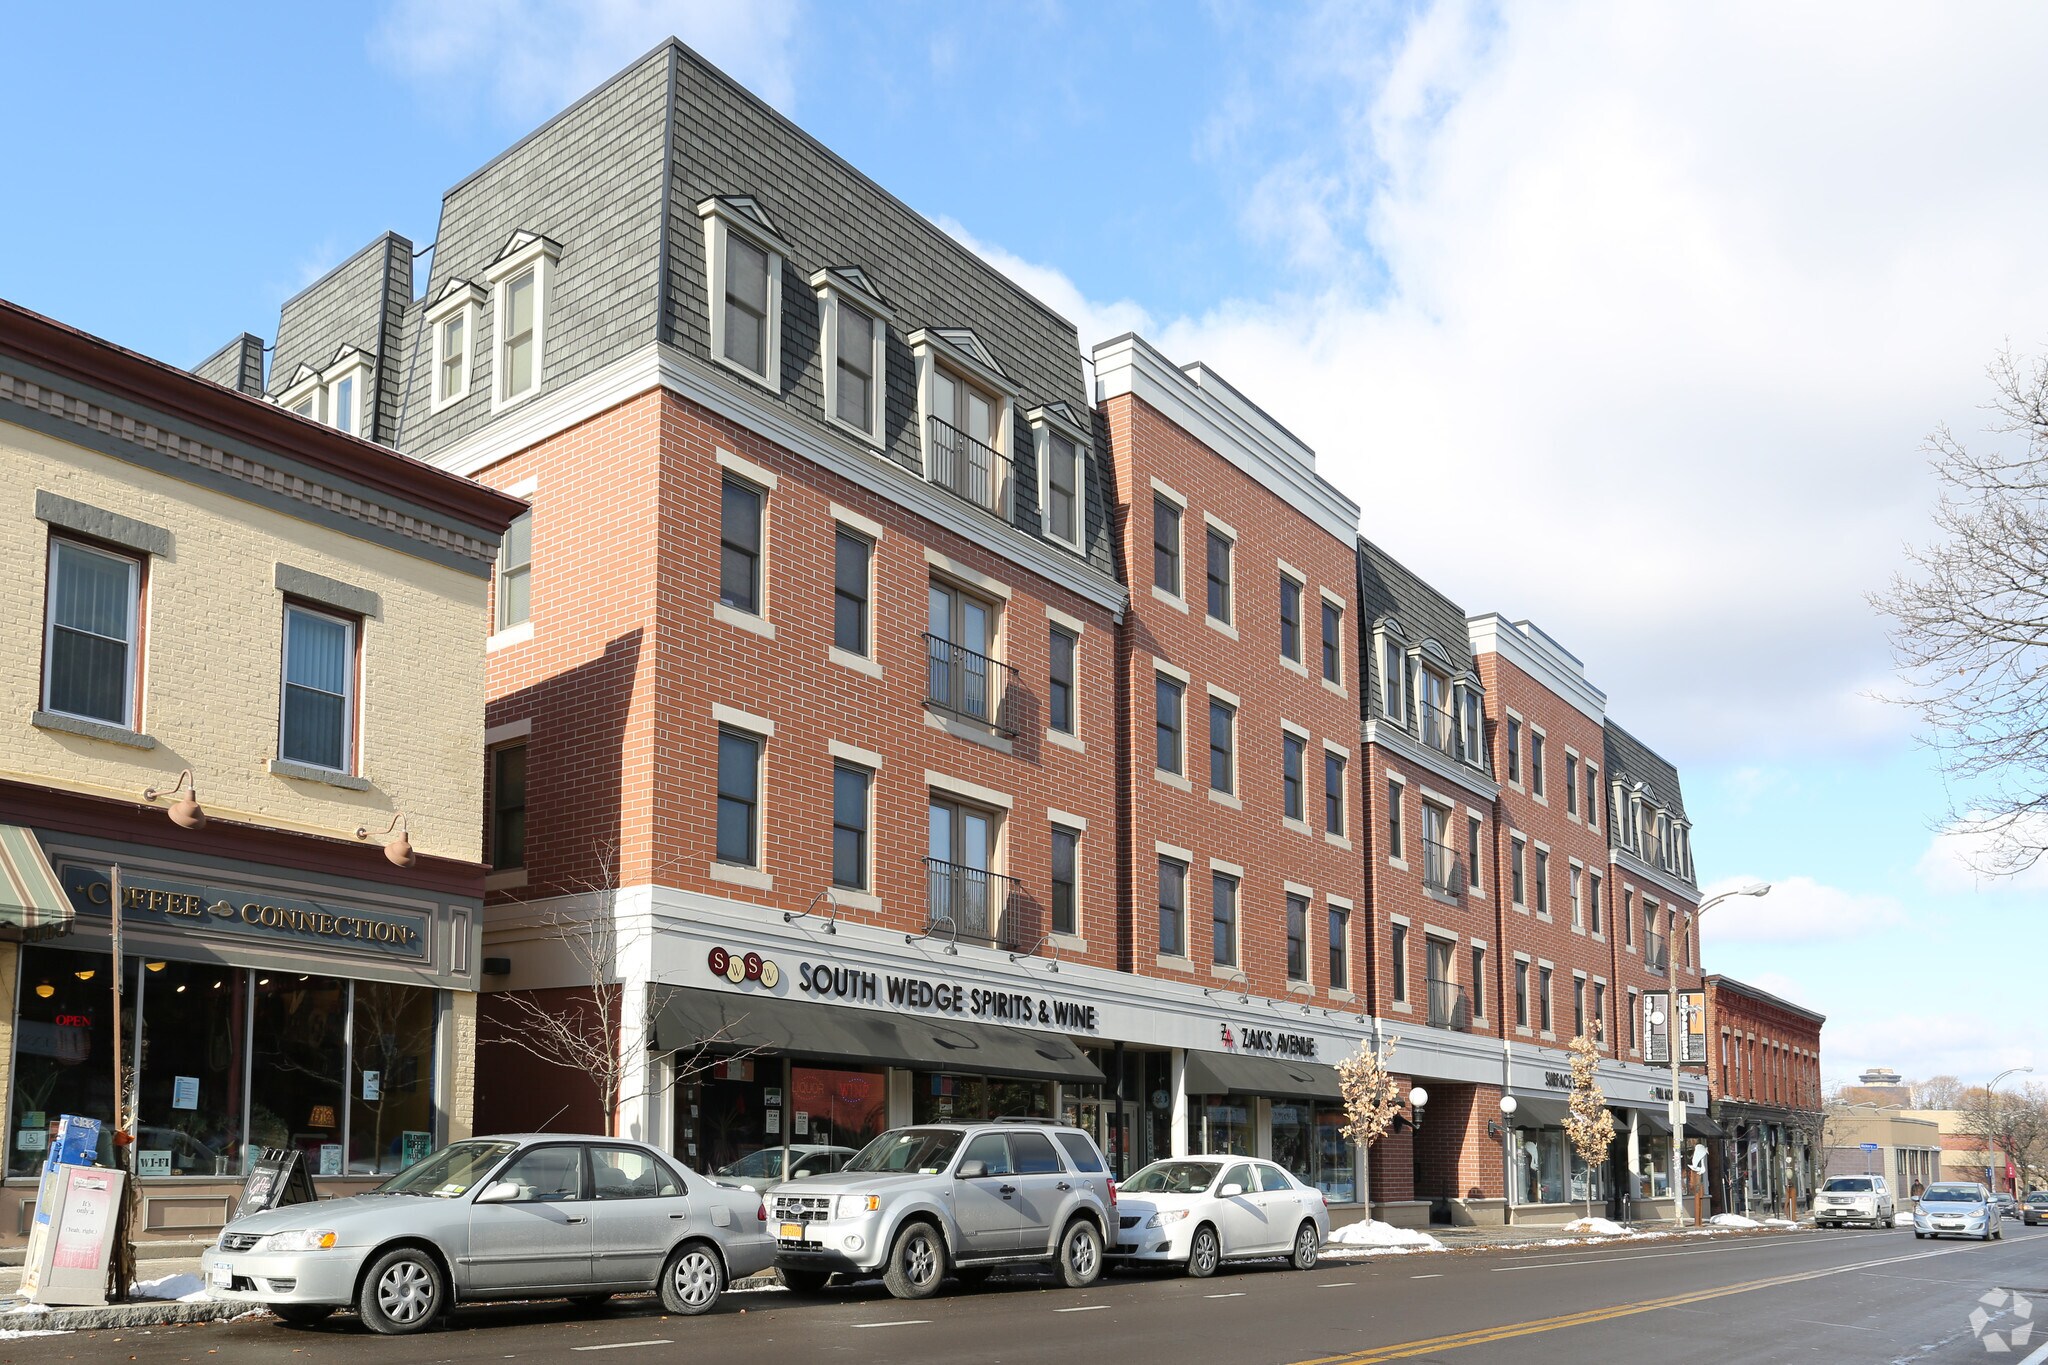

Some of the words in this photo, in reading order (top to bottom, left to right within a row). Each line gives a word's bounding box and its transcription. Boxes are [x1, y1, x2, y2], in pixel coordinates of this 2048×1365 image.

[87, 882, 201, 917] COFFEE
[241, 903, 408, 944] CONNECTION
[799, 961, 876, 1001] SOUTH
[886, 975, 963, 1012] WEDGE
[970, 988, 1033, 1021] SPIRITS
[1038, 1000, 1050, 1023] &
[1053, 1000, 1095, 1030] WINE
[55, 1014, 91, 1027] OPEN
[1242, 1028, 1273, 1051] ZAK'S
[1277, 1033, 1315, 1056] AVENUE
[792, 1081, 824, 1096] LIQUOR
[140, 1157, 170, 1168] WI-FI
[76, 1207, 89, 1215] only
